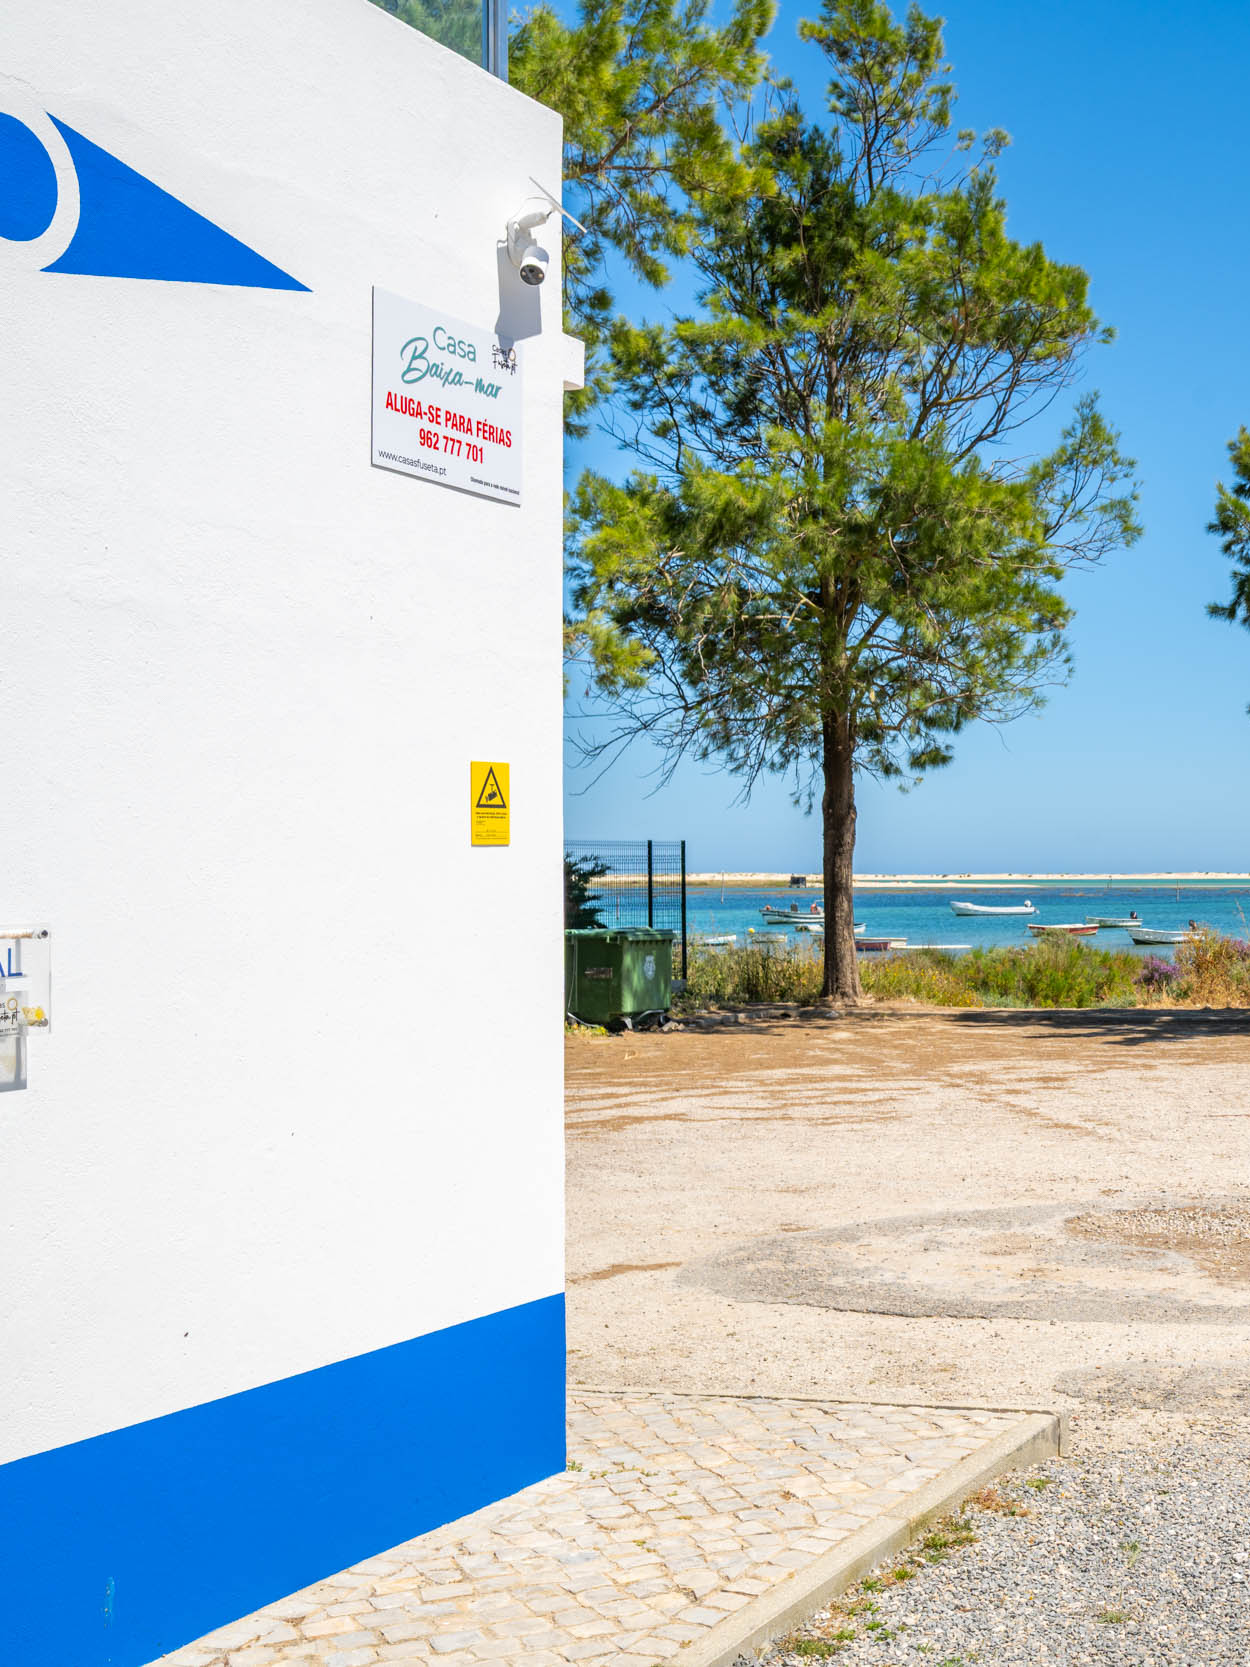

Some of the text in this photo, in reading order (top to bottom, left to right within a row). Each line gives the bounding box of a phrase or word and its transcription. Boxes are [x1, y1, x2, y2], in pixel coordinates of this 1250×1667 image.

[433, 326, 477, 362] Casa
[400, 336, 502, 399] Baixa-mar
[385, 391, 512, 448] ALUGA-SE PARA FÉRIAS
[378, 449, 448, 477] www.casasfuseta.pt
[419, 428, 484, 464] 962 777 701
